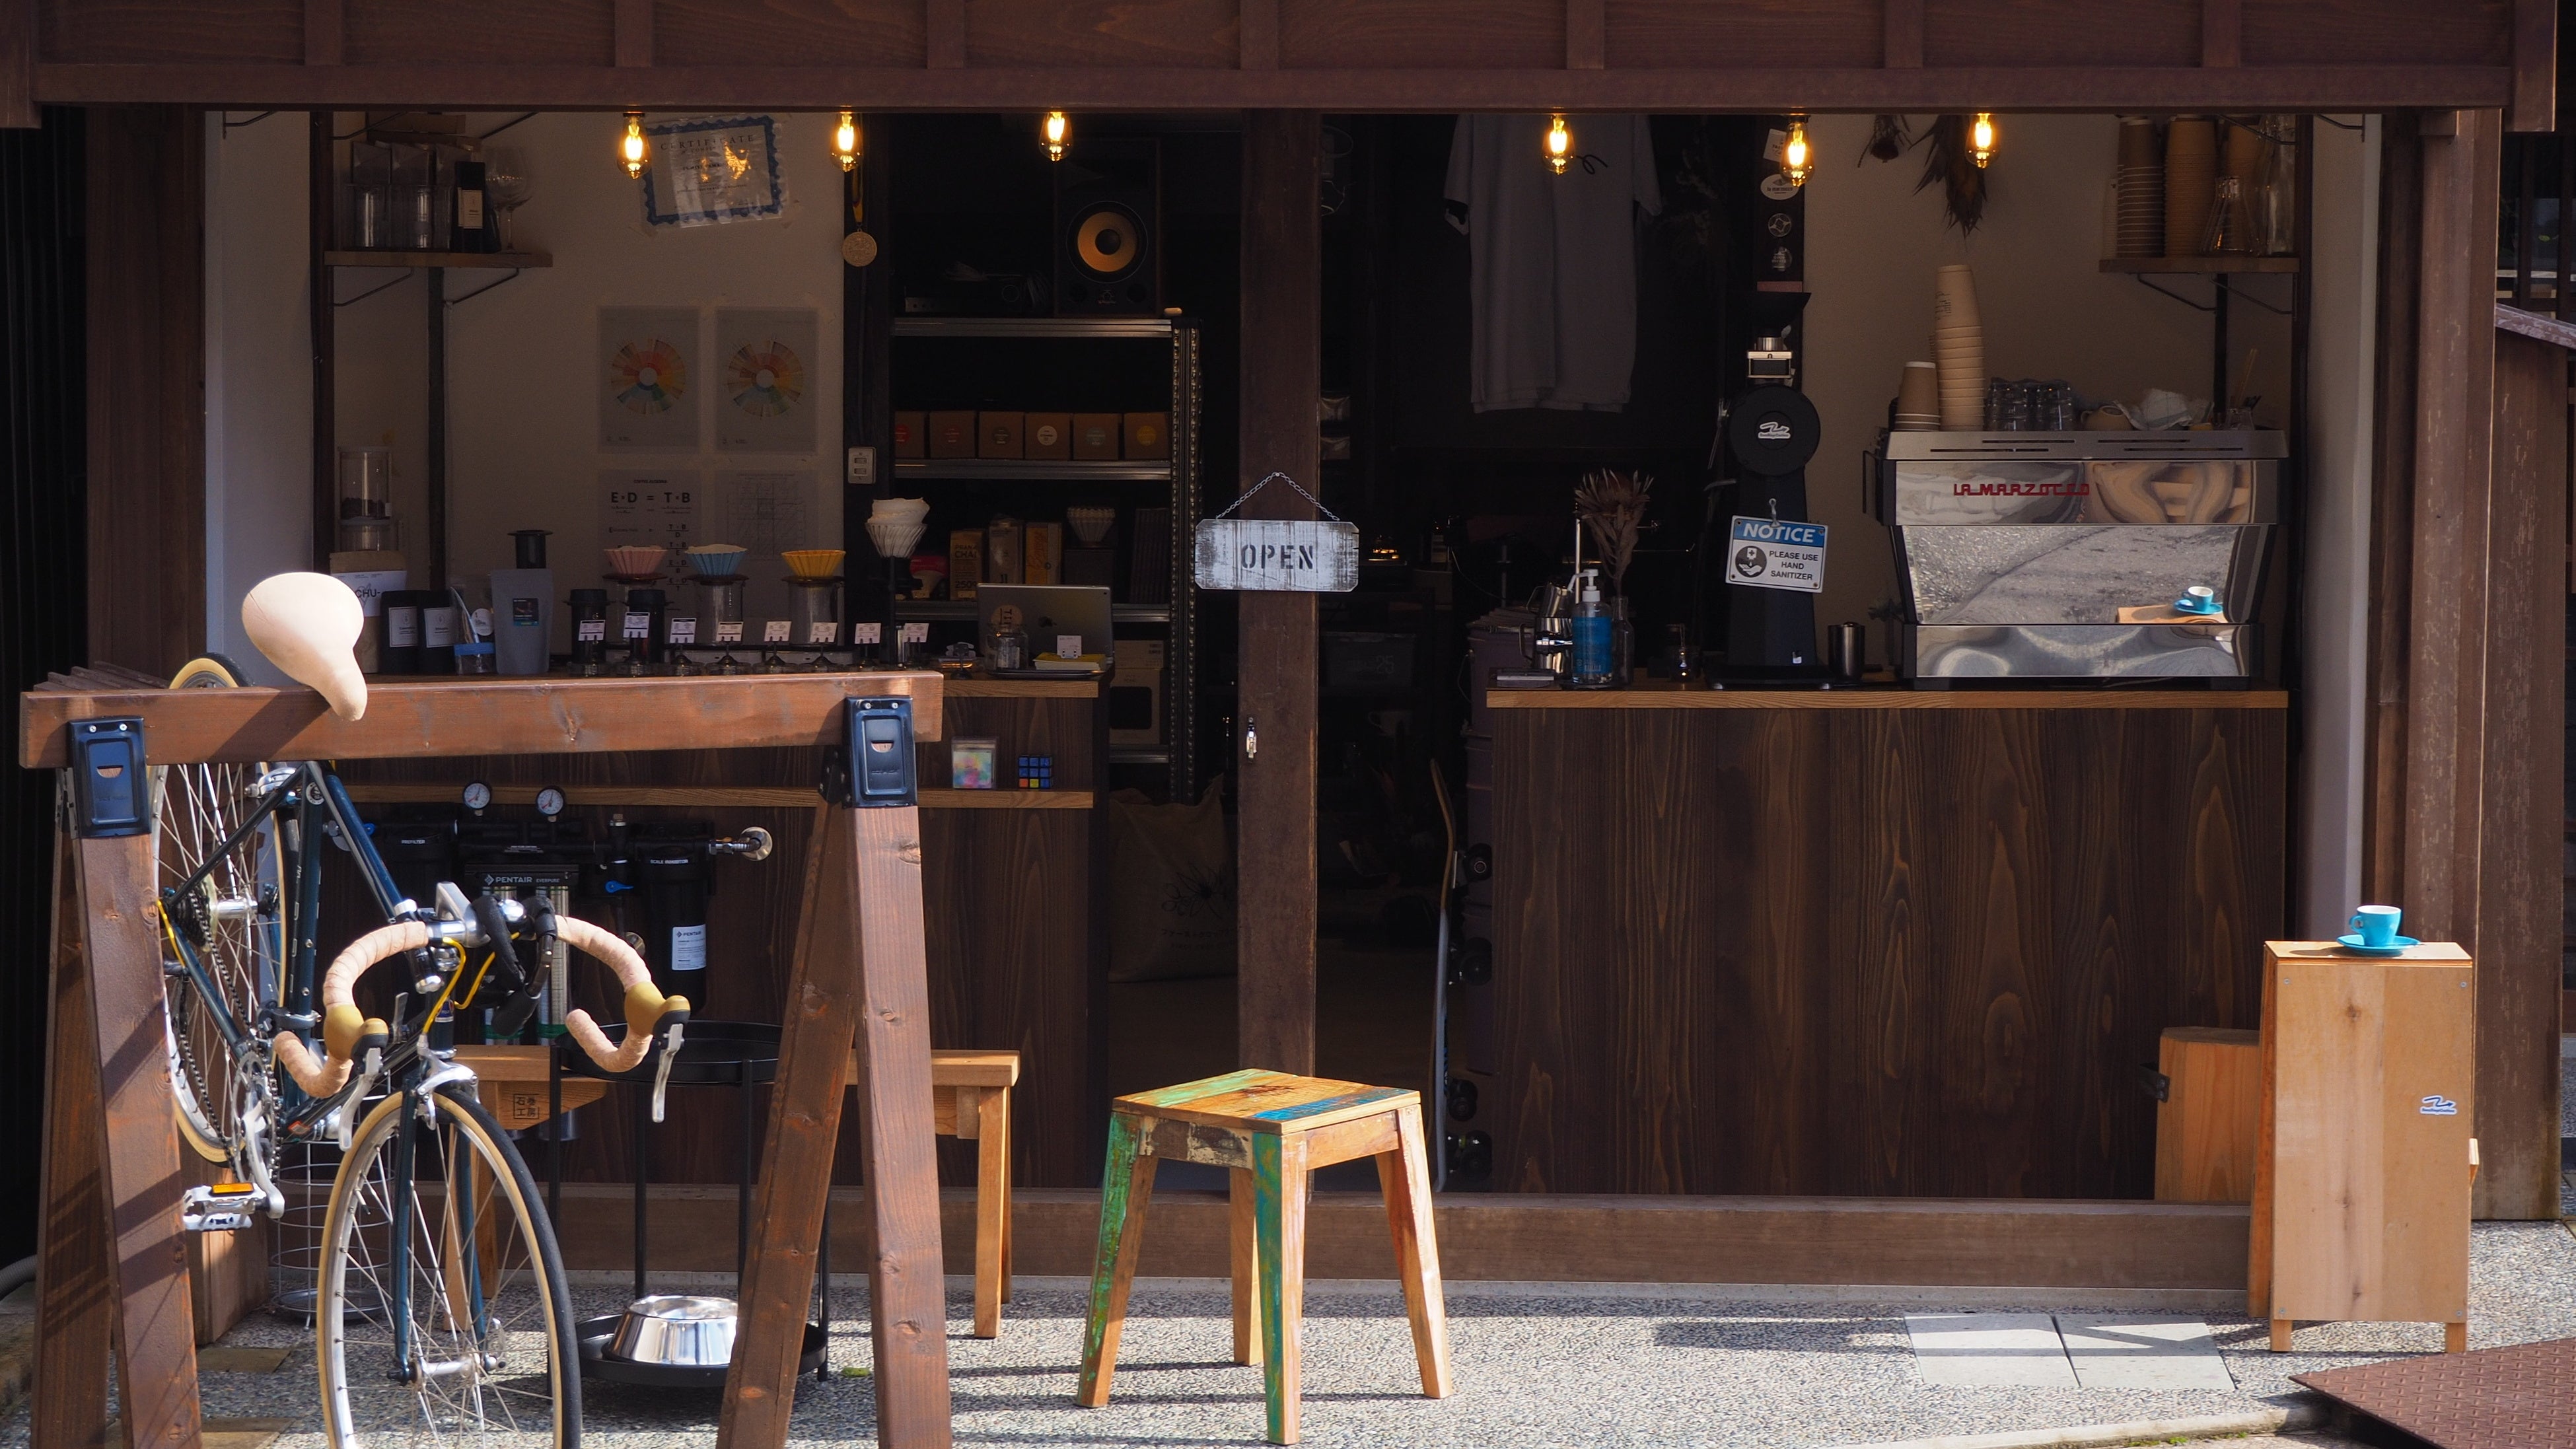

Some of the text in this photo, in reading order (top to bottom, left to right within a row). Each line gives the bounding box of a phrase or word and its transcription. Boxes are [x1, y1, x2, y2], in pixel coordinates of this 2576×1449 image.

[1742, 522, 1816, 543] NOTICE
[1241, 544, 1313, 569] OPEN
[1769, 550, 1801, 560] PLEASE
[1781, 561, 1805, 570] HAND
[1770, 570, 1813, 581] SANITIZER
